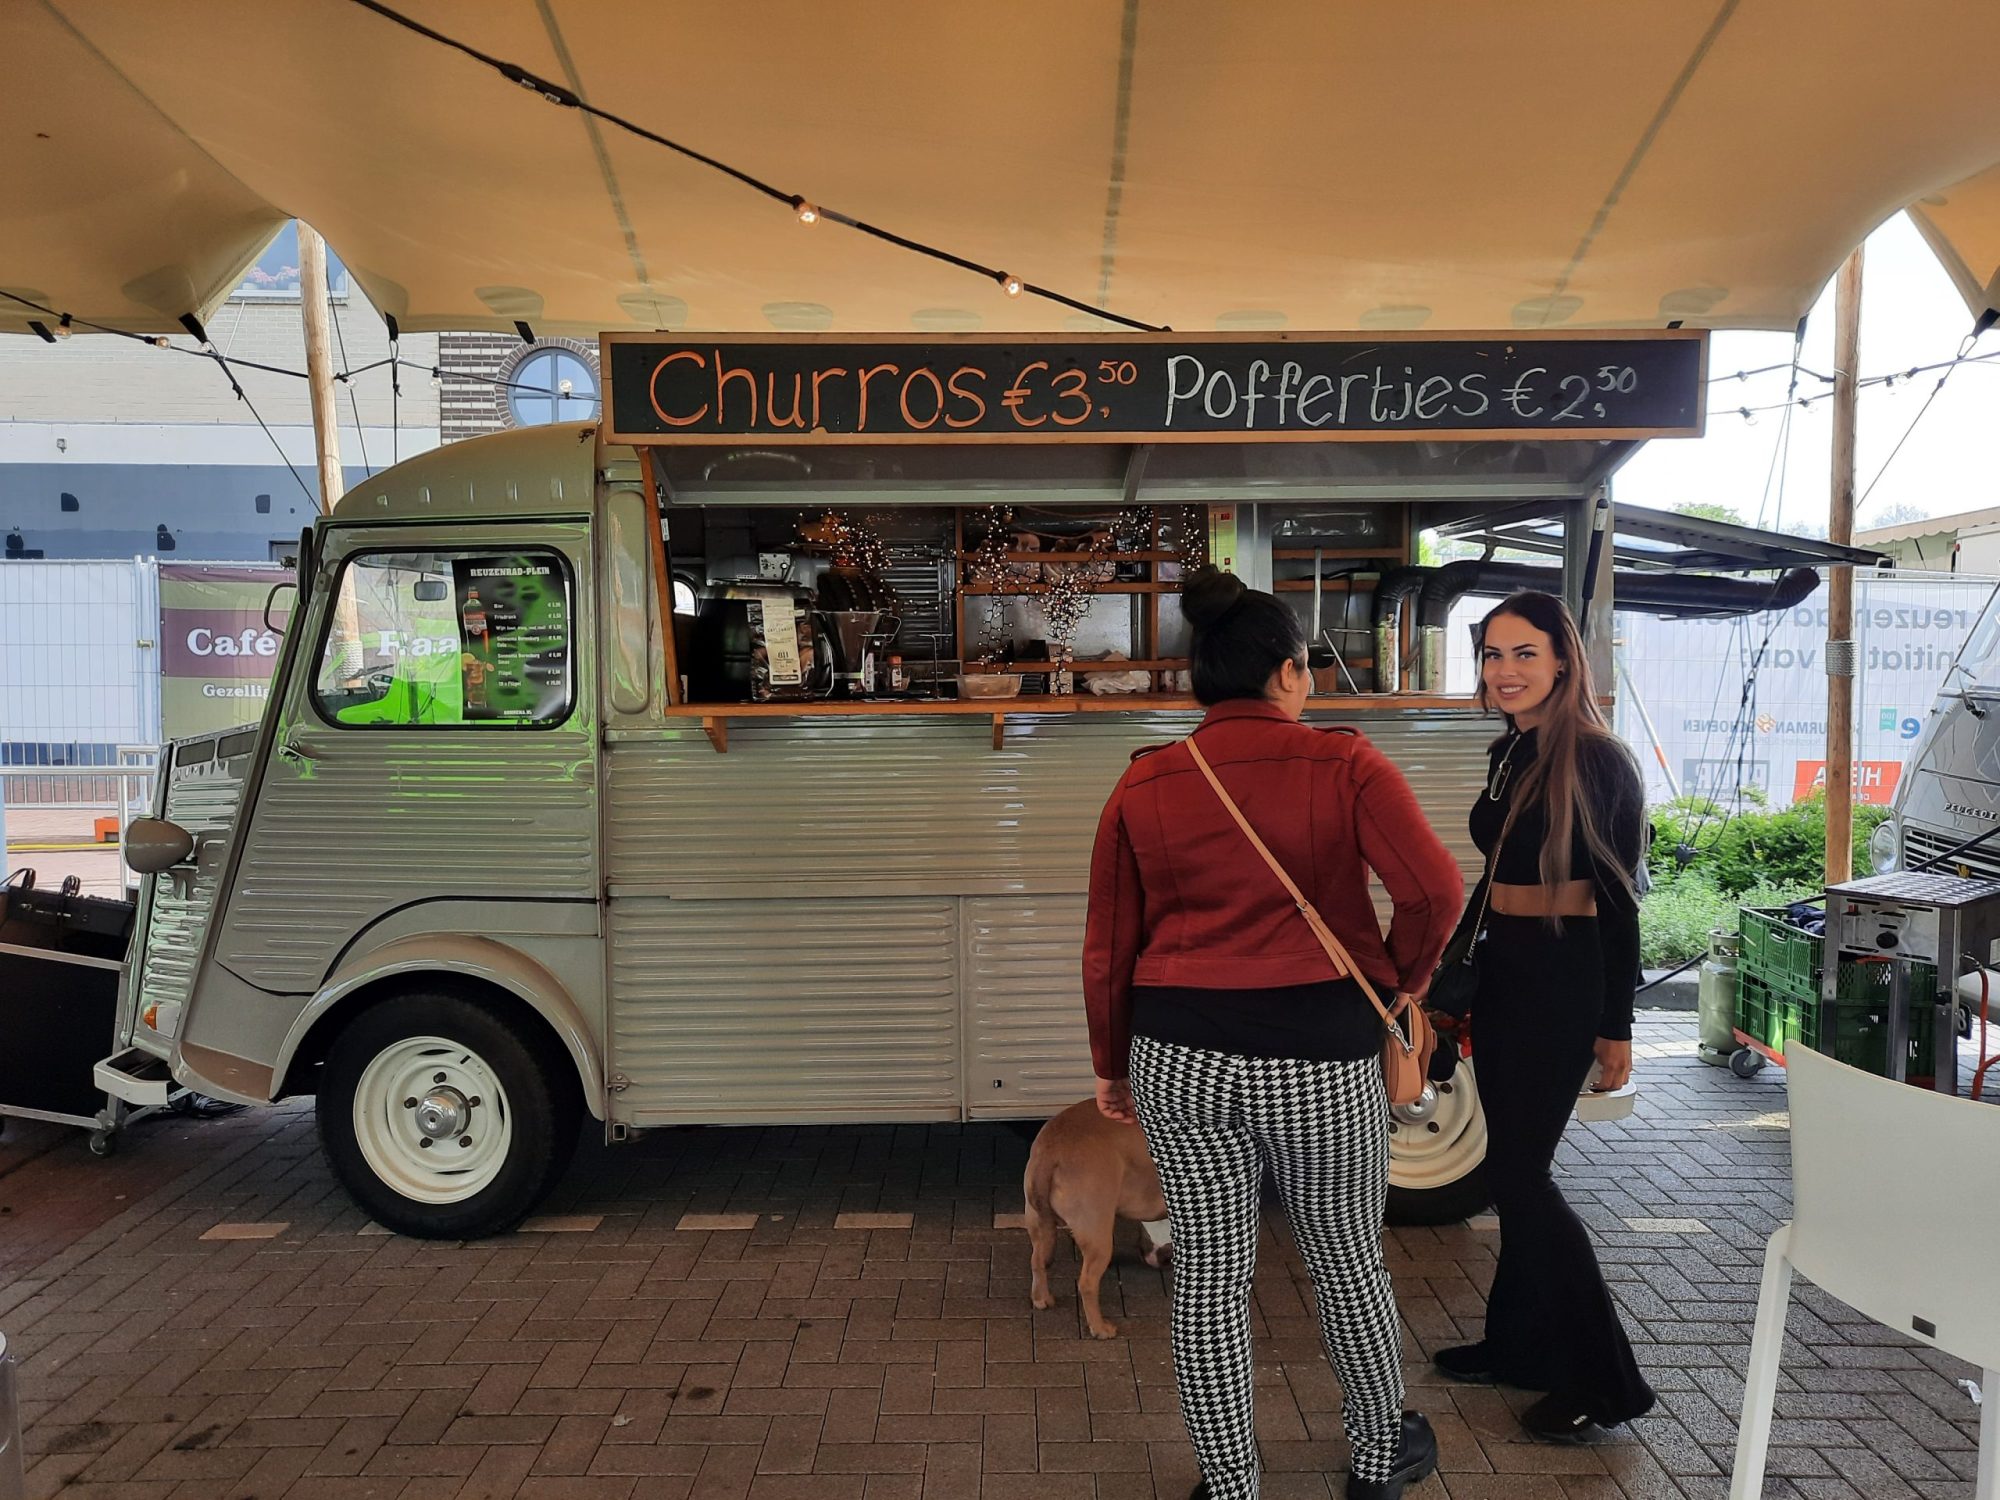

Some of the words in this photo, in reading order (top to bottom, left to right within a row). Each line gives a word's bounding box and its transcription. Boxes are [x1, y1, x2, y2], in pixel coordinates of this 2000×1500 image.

[649, 348, 988, 431] Churros
[1165, 354, 1490, 428] Poffertjes
[470, 566, 550, 577] REUZENRAD-PLEIN
[186, 627, 277, 656] Café
[1942, 802, 1997, 822] PEUGEOT
